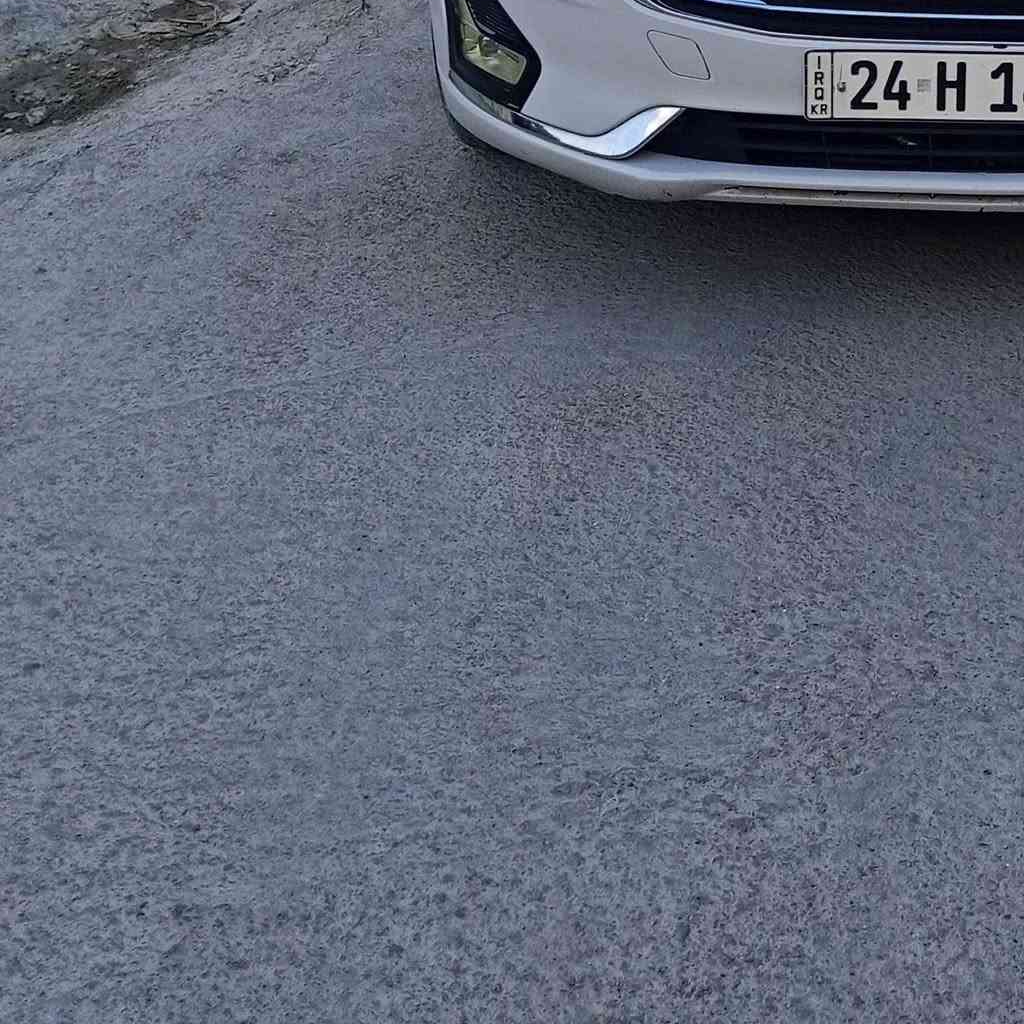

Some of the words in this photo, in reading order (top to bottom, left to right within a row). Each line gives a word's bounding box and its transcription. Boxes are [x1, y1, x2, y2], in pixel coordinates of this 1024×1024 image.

[850, 60, 911, 111] 24
[936, 61, 967, 112] H
[811, 104, 828, 115] KR
